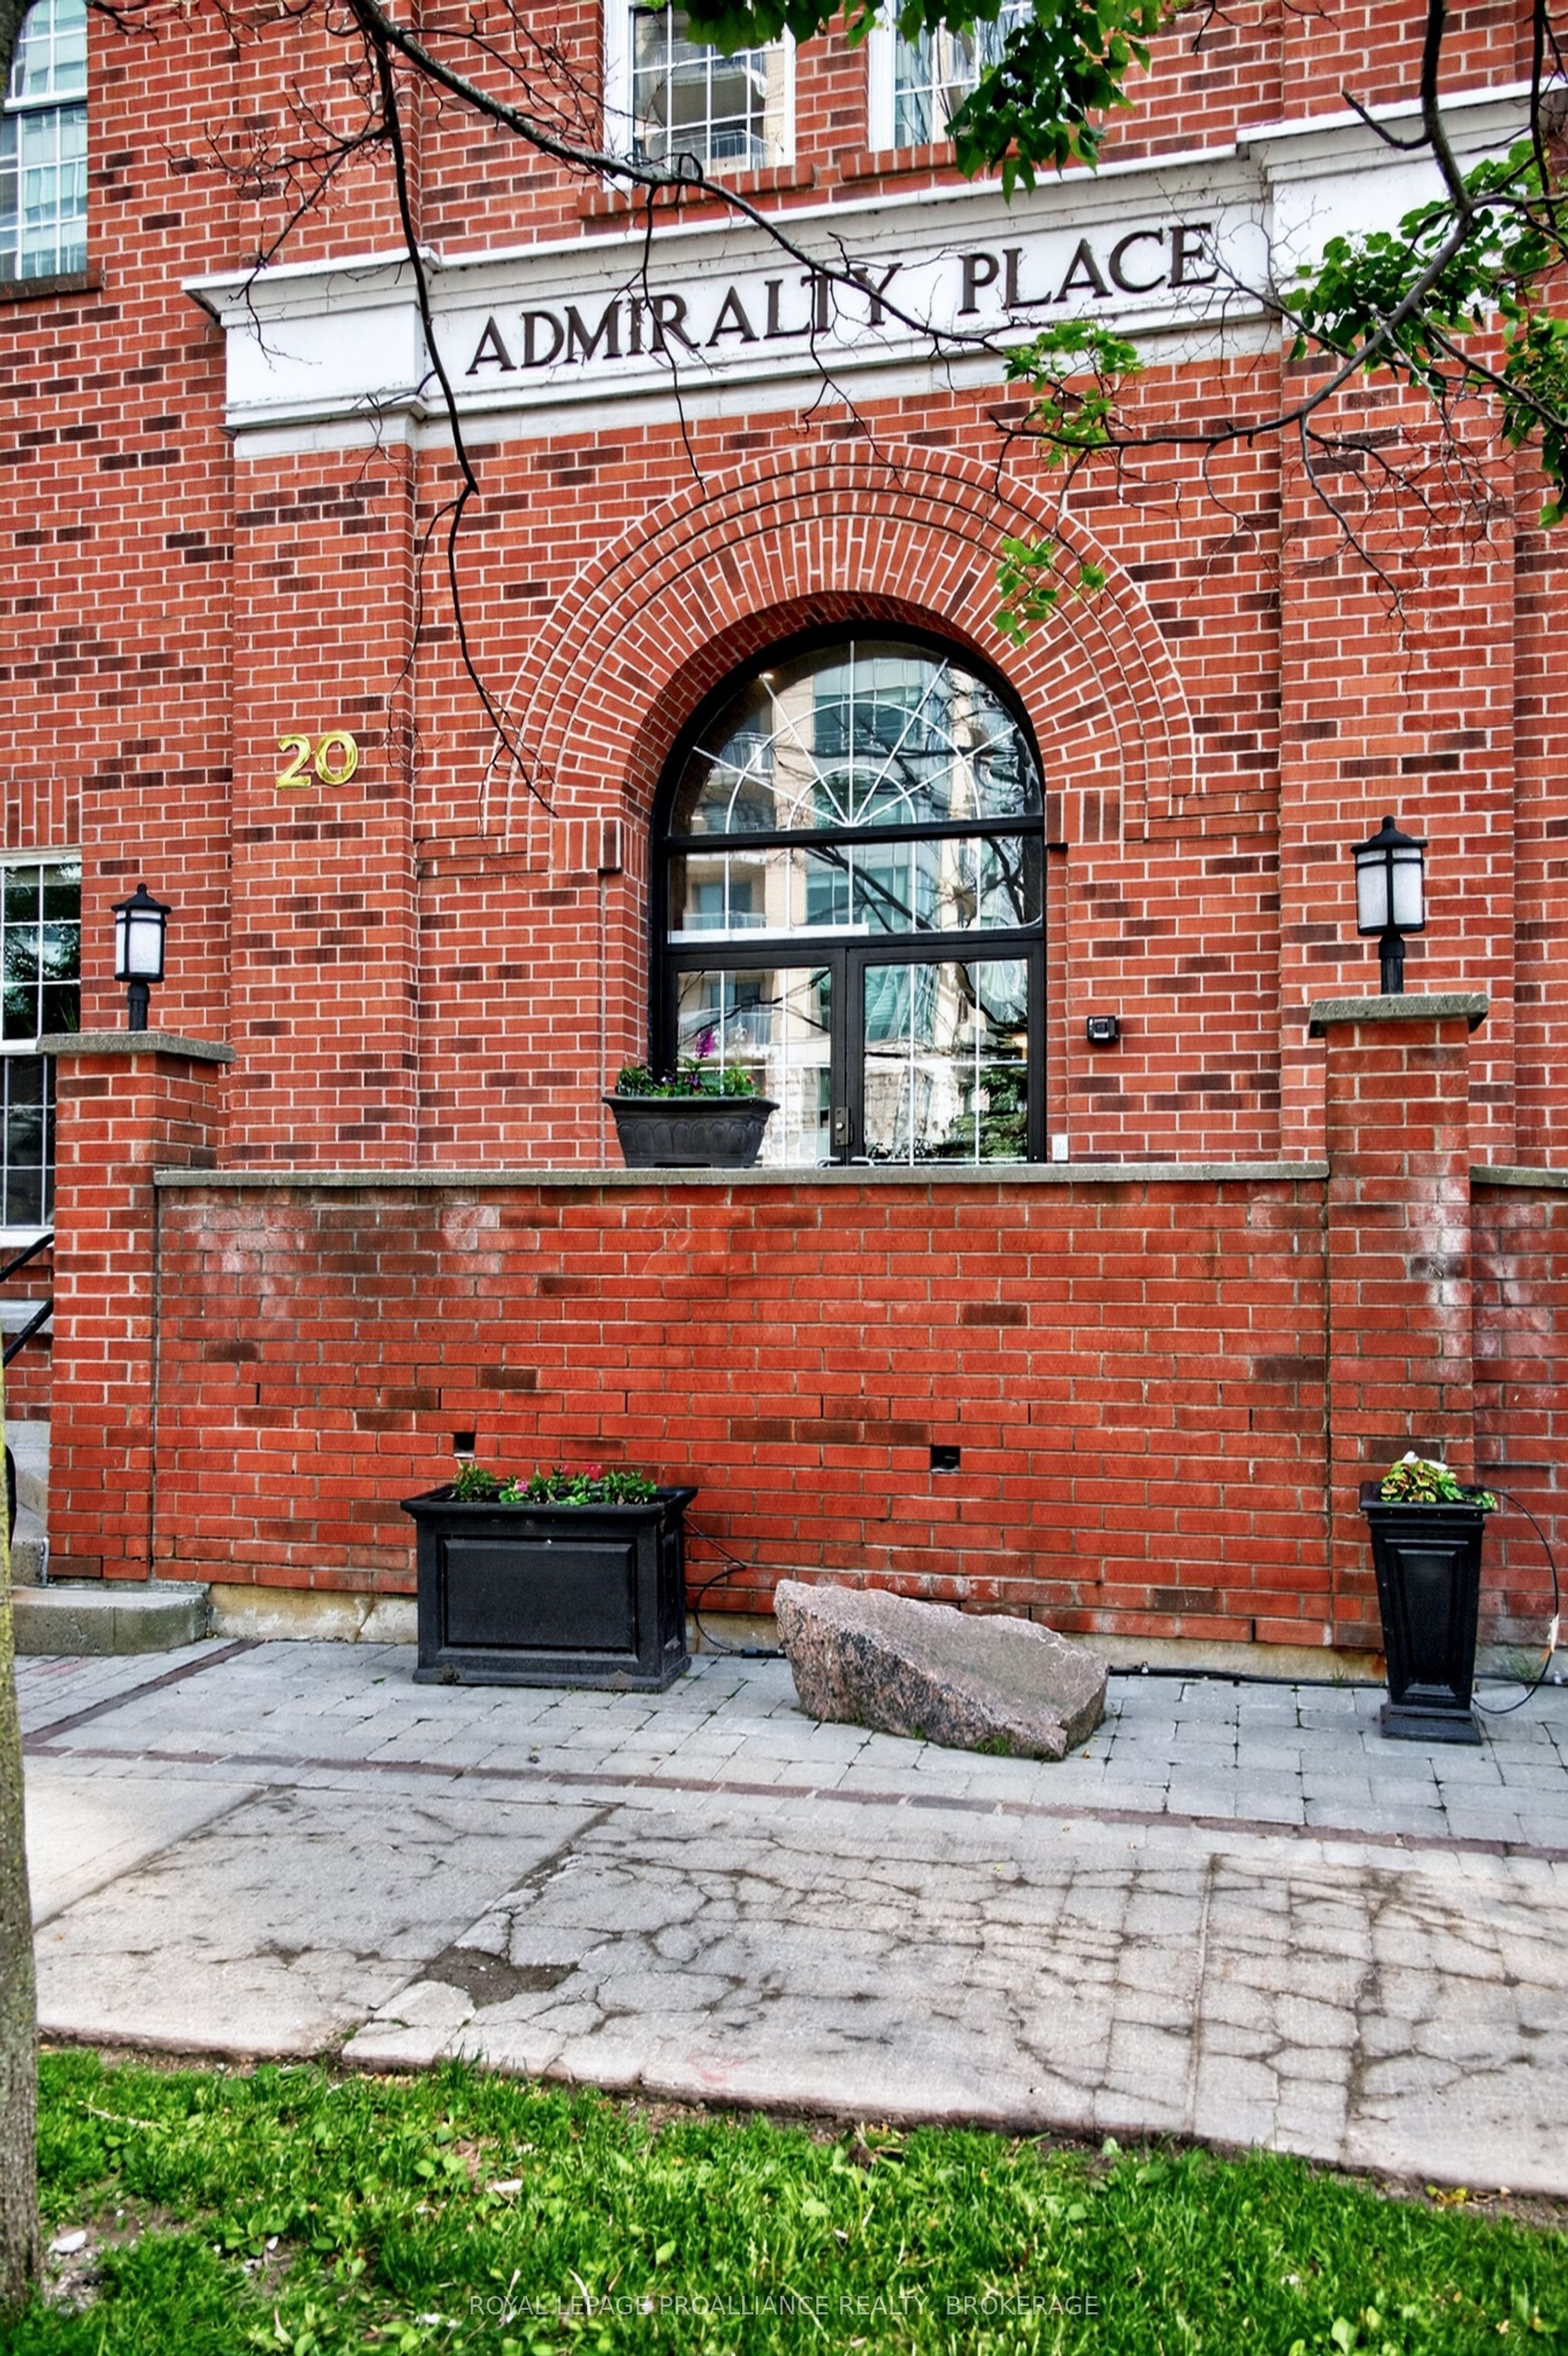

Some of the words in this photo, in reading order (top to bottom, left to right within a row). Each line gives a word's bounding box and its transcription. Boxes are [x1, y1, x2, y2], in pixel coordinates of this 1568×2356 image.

[465, 262, 903, 374] ADMIRALTY
[957, 222, 1219, 316] PLACE
[275, 730, 358, 789] 20
